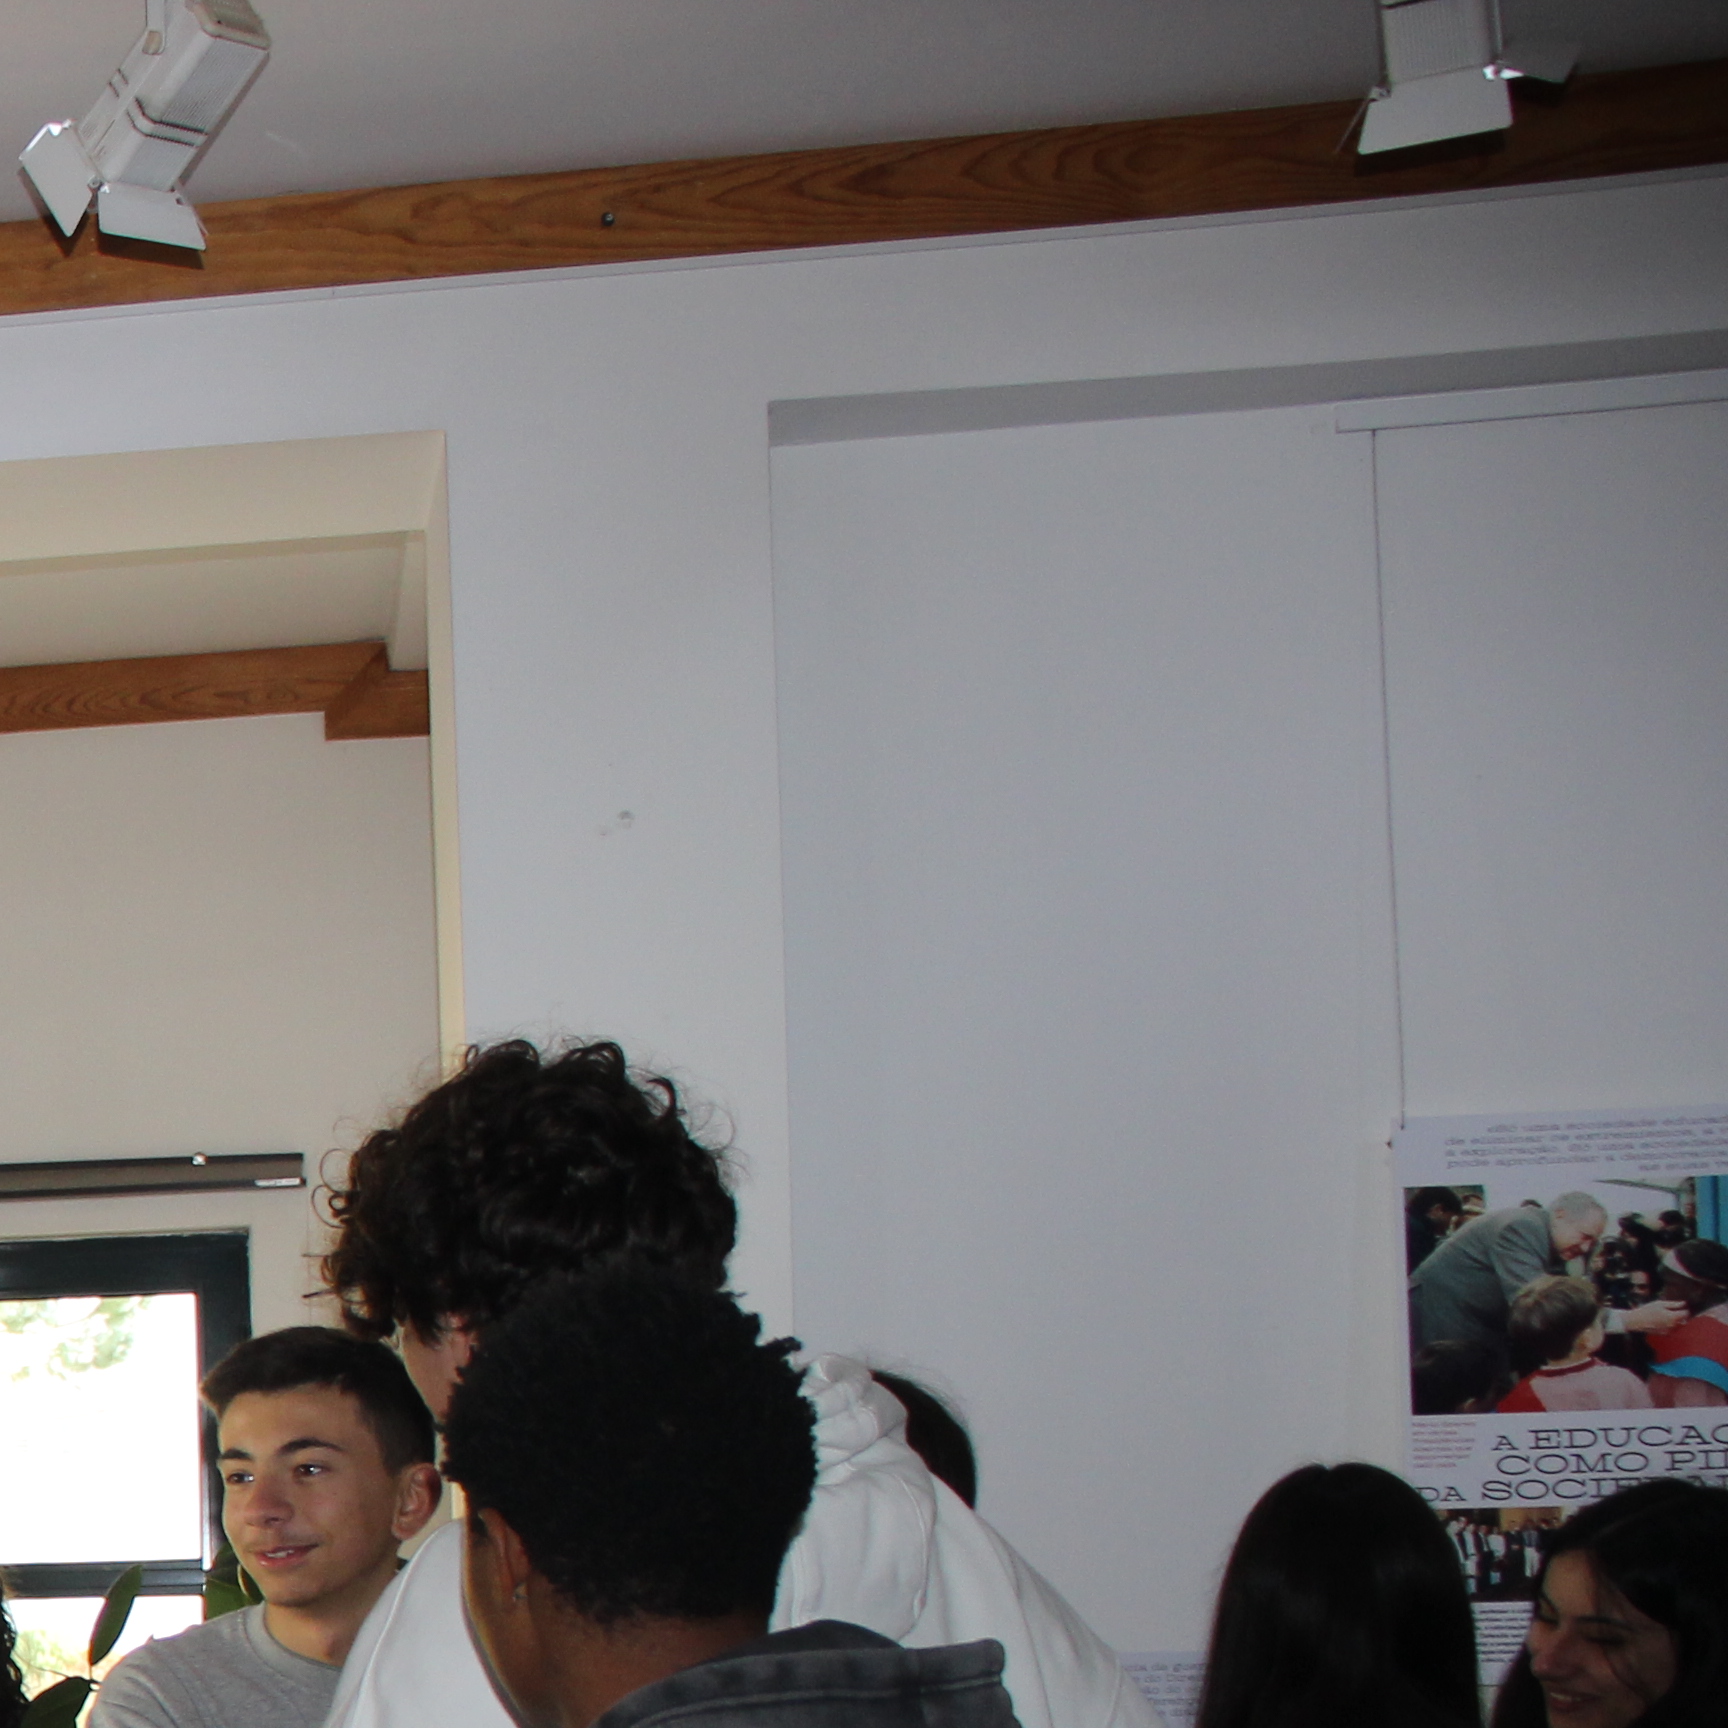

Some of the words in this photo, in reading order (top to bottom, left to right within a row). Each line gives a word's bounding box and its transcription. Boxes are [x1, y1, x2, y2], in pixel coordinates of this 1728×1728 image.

[1492, 1434, 1519, 1451] A
[1496, 1451, 1649, 1476] COMO
[1416, 1486, 1467, 1502] DA
